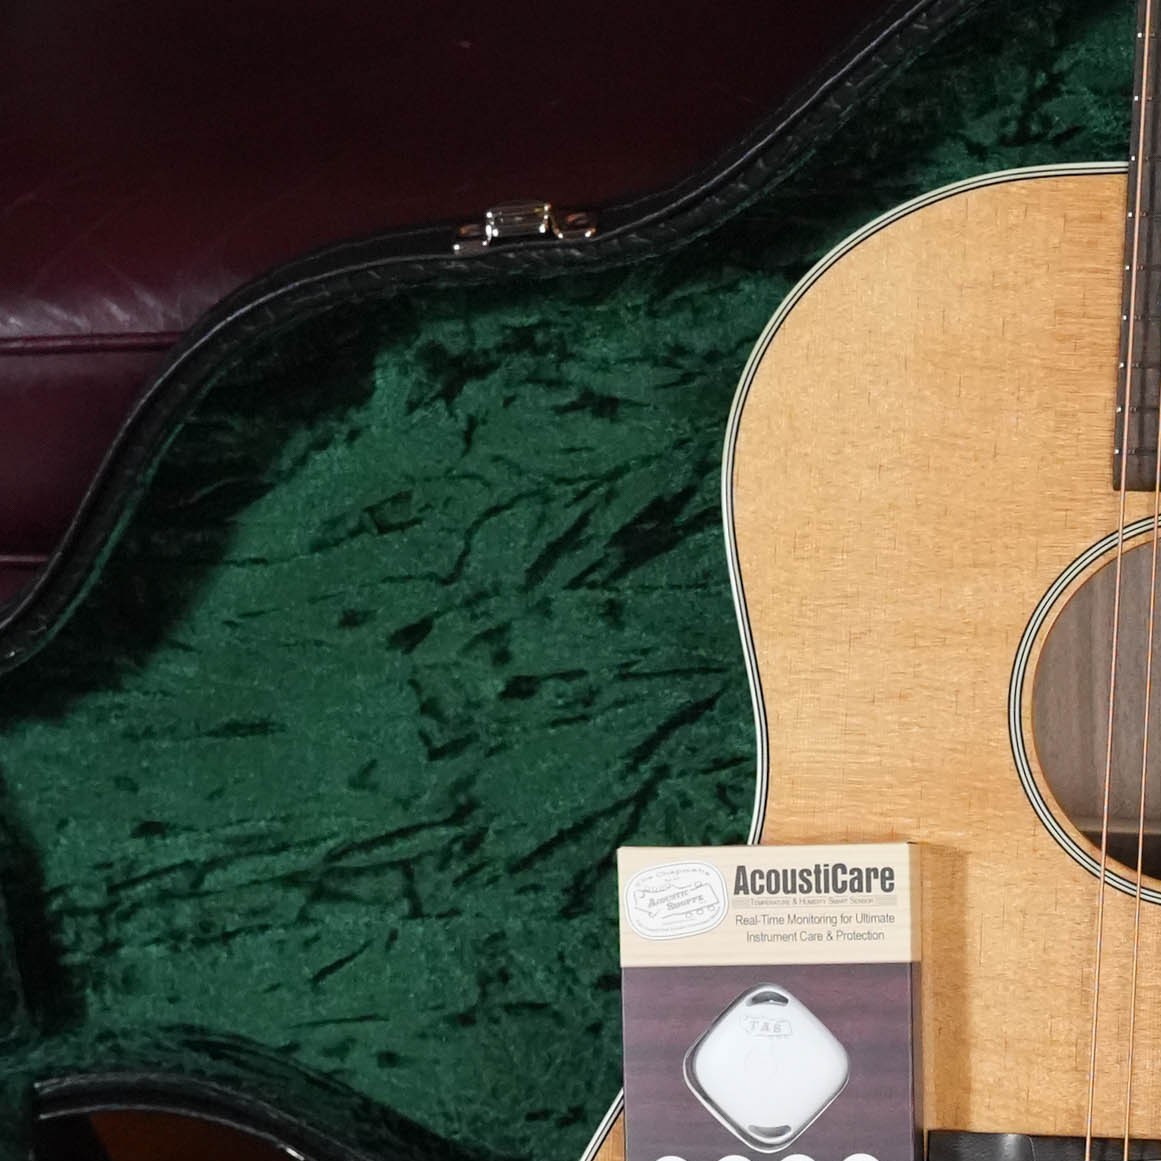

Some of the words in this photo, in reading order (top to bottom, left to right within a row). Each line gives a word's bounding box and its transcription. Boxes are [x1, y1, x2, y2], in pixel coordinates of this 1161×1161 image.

[733, 863, 895, 895] AcoustiCare
[736, 914, 784, 926] Real-Time
[788, 913, 838, 927] Monitoring
[840, 913, 852, 925] for
[855, 913, 895, 924] Ultimate
[746, 931, 797, 942] Instrument
[799, 931, 823, 942] Care
[826, 931, 833, 941] &
[836, 930, 885, 941] Protection
